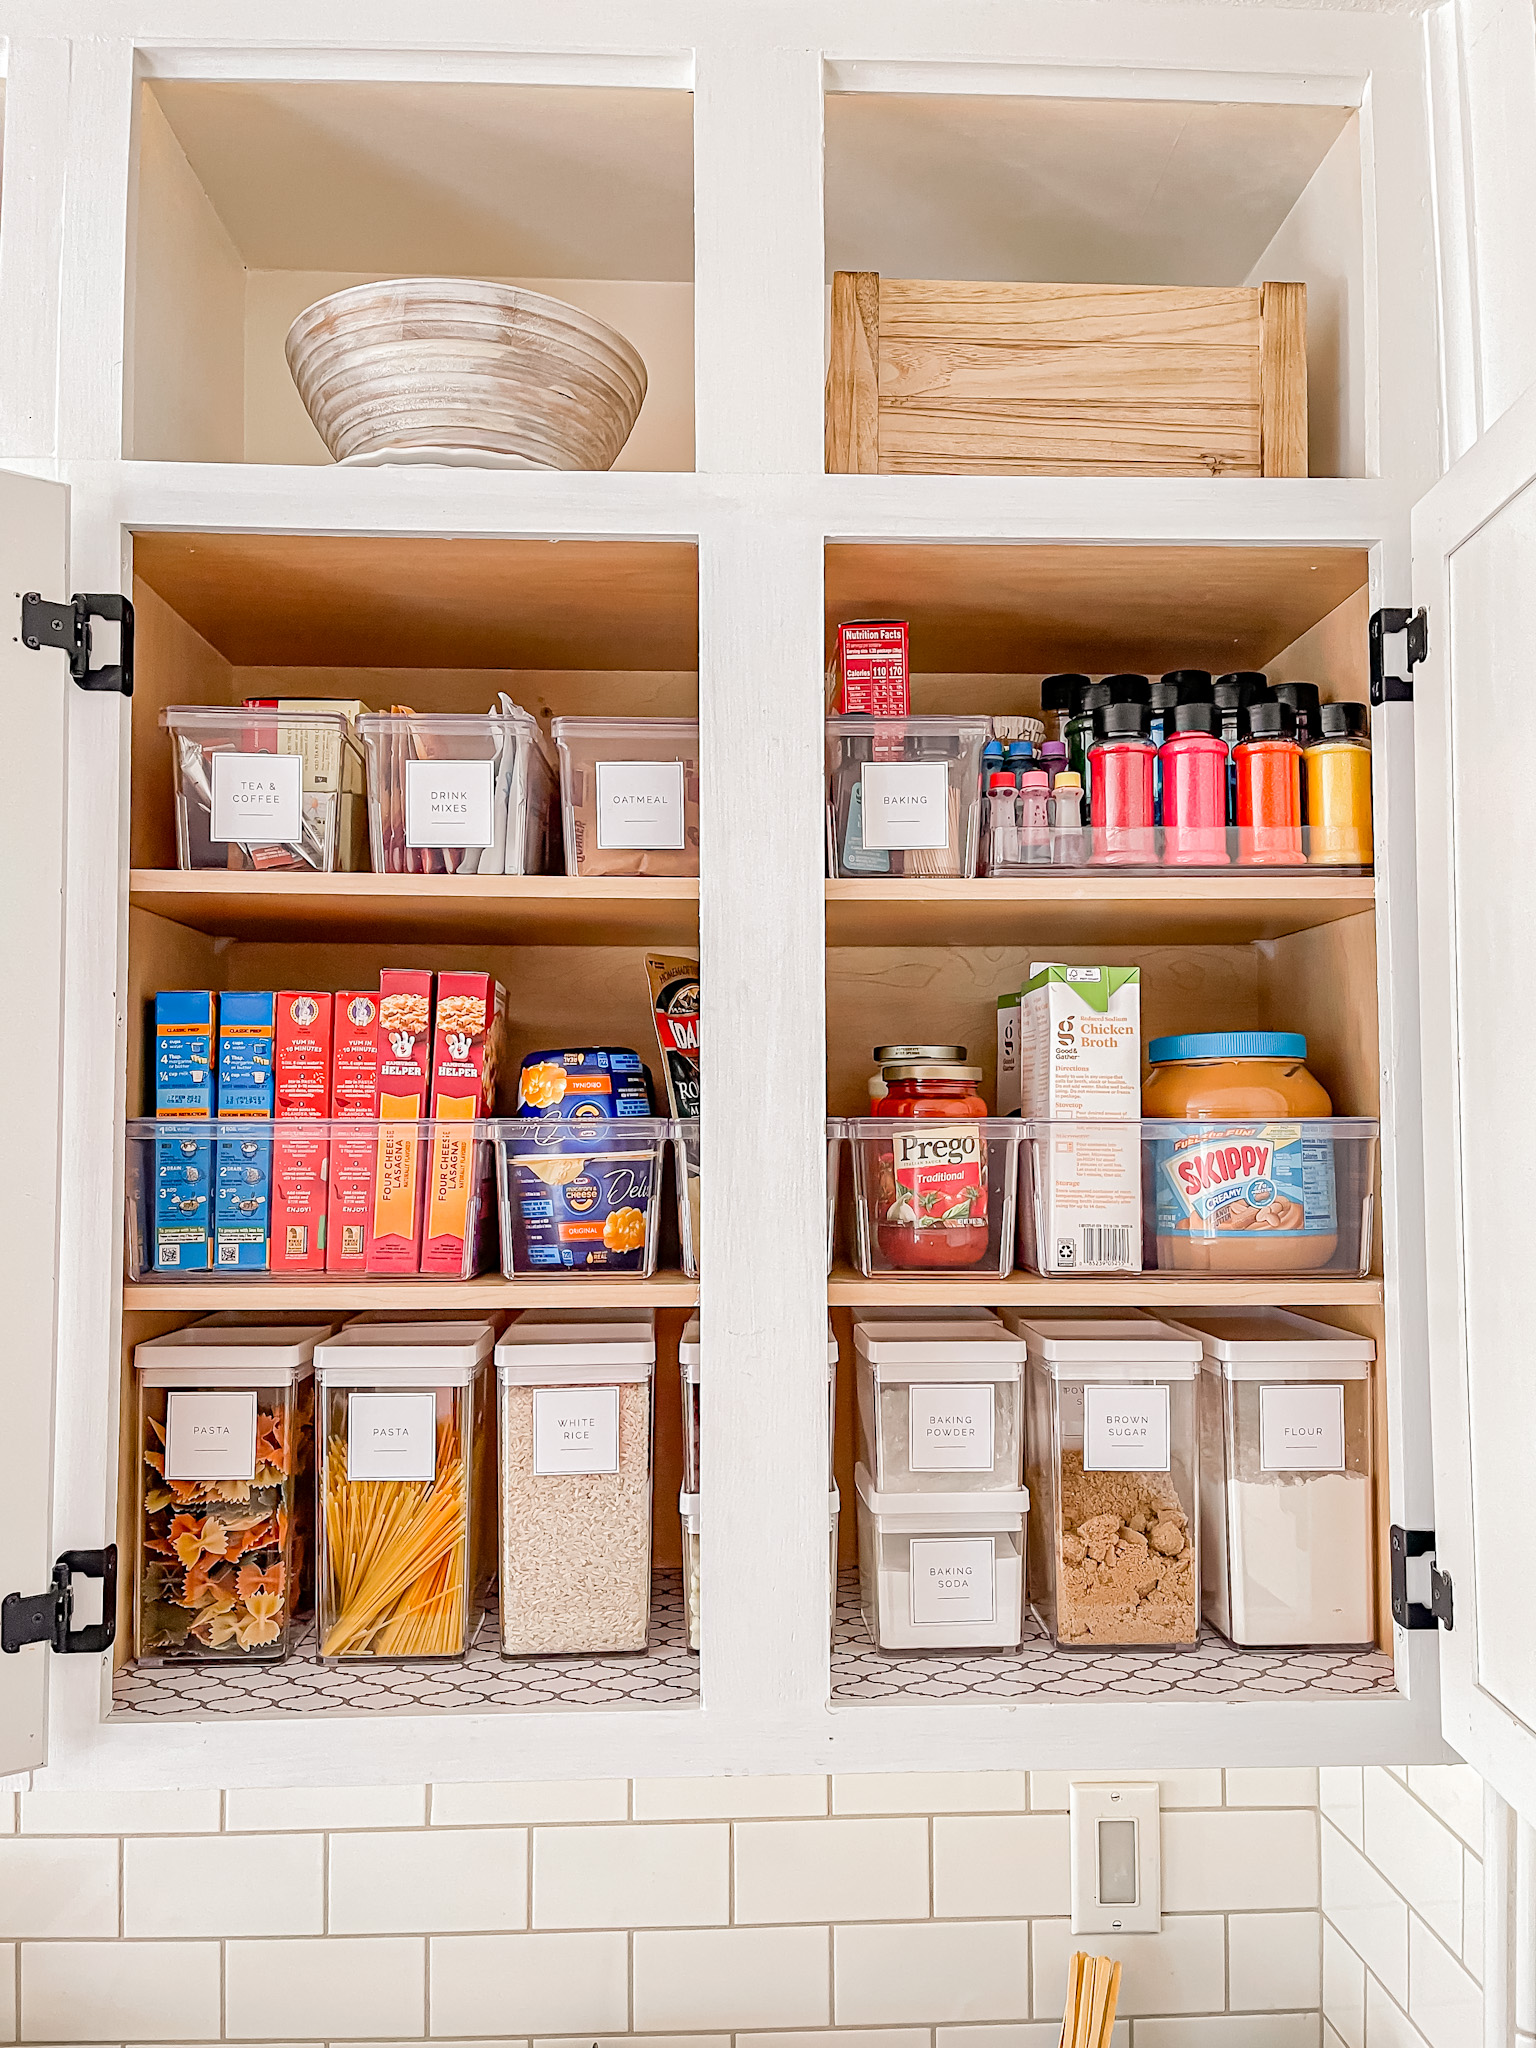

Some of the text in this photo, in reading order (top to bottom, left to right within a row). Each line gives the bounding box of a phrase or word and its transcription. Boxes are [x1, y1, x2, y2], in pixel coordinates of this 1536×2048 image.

[846, 630, 901, 640] Nutrition Facts
[873, 666, 902, 676] 110 170
[240, 781, 277, 791] TEA &
[232, 794, 280, 804] COFFEE
[430, 791, 468, 800] DRINK
[612, 795, 668, 805] OATMEAL
[883, 795, 928, 805] BAKING
[431, 804, 467, 813] MIXES
[1080, 1024, 1134, 1034] Chicken
[161, 1040, 168, 1049] 6
[224, 1041, 230, 1049] 6
[1081, 1037, 1118, 1047] Broth
[161, 1054, 168, 1064] 4
[223, 1055, 230, 1065] 4
[381, 1065, 422, 1076] HELPER
[438, 1066, 478, 1077] HELPER
[1225, 1128, 1256, 1139] FUN!
[900, 1135, 975, 1164] Prego
[383, 1130, 394, 1201] FOUR CHEESE
[393, 1139, 403, 1189] LASAGNA
[438, 1131, 451, 1201] FOUR CHEESE
[448, 1140, 459, 1189] LASAGNA
[160, 1167, 166, 1176] 2
[220, 1167, 226, 1177] 2
[1178, 1146, 1269, 1195] SKIPPY
[917, 1169, 965, 1185] Traditional
[160, 1188, 166, 1198] 3
[220, 1189, 226, 1198] 3
[1206, 1187, 1243, 1210] CREAMY
[557, 1418, 595, 1428] WHITE
[929, 1415, 972, 1425] BAKING
[1106, 1415, 1149, 1424] BROWN
[193, 1426, 230, 1435] PASTA
[372, 1427, 409, 1437] PASTA
[563, 1431, 589, 1440] RICE
[926, 1428, 975, 1437] POWDER
[1108, 1428, 1147, 1437] SUGAR
[1284, 1427, 1323, 1436] FLOUR
[929, 1566, 973, 1576] BAKING
[937, 1579, 969, 1589] SODA
